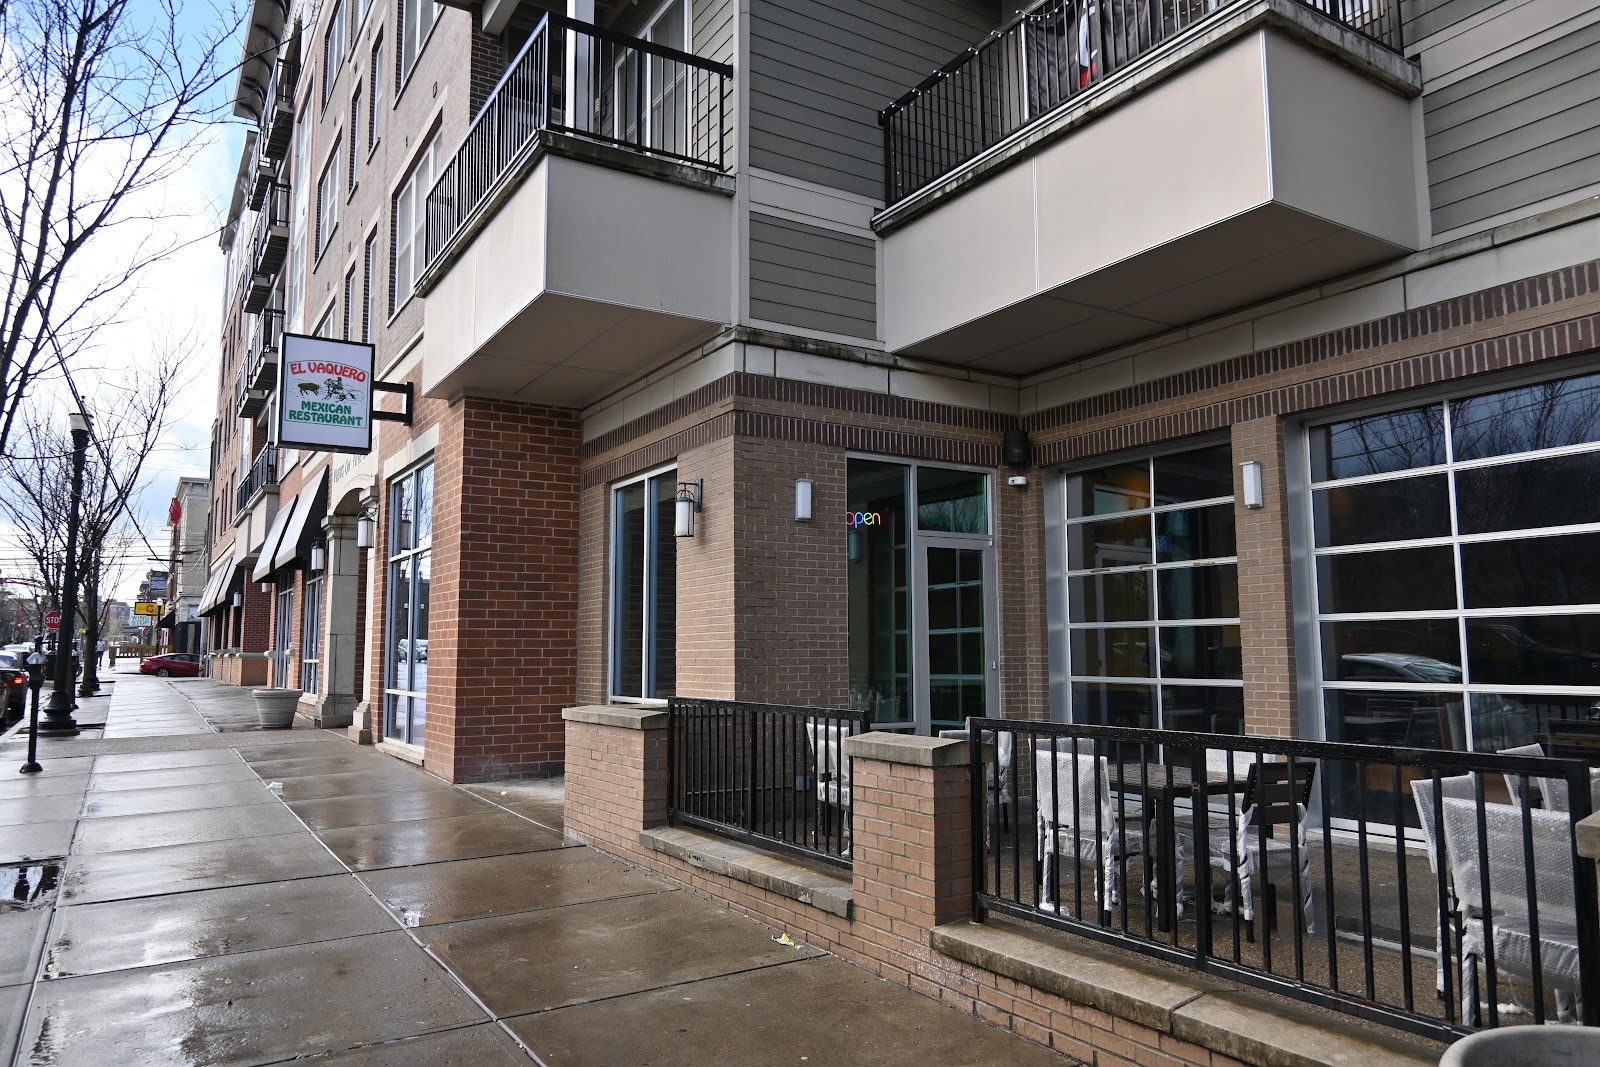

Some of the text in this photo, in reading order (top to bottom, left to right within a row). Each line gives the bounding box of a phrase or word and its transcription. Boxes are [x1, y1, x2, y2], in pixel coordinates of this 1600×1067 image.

[290, 362, 366, 383] EL VAQUERO
[301, 400, 351, 415] MEXICAN
[288, 410, 363, 426] RESTAURANT
[846, 511, 881, 529] open
[45, 616, 60, 624] STO
